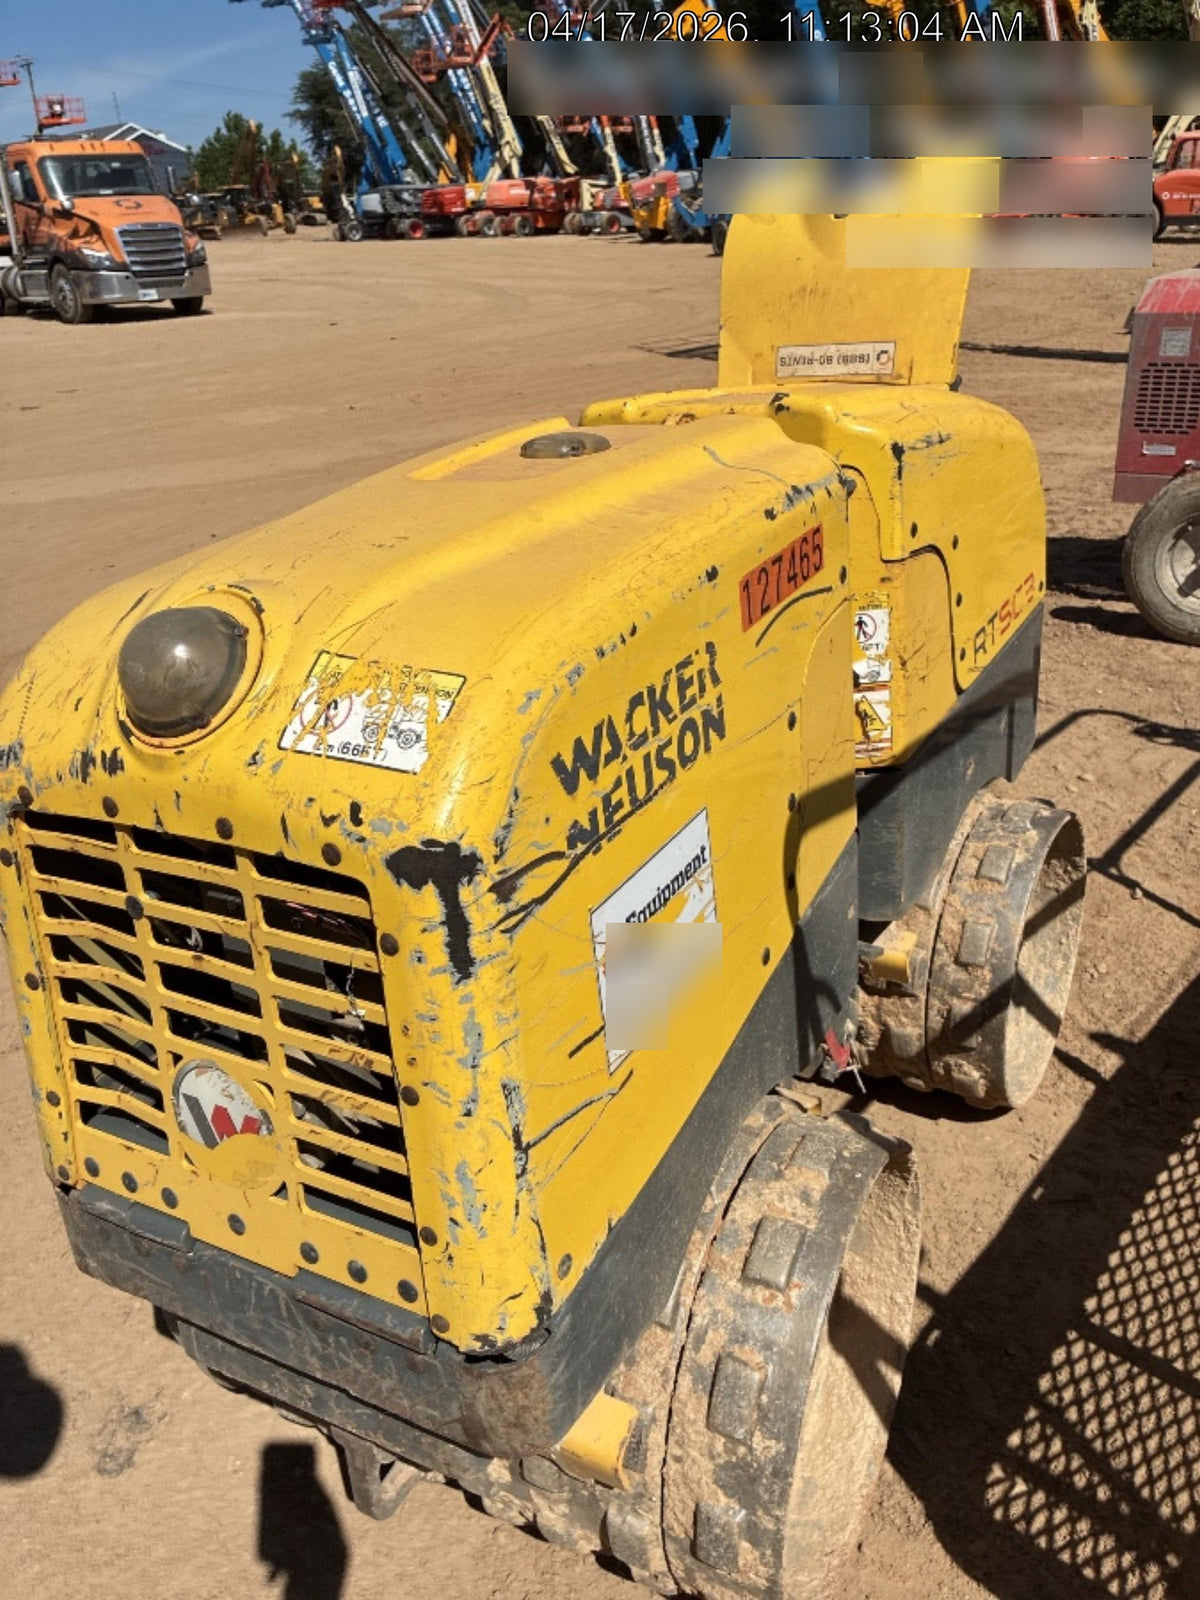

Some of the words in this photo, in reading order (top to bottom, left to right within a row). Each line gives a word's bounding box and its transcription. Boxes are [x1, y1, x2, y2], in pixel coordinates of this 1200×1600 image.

[742, 527, 824, 625] 127465
[551, 641, 721, 796] WACKER
[567, 694, 726, 851] NEUSON
[625, 844, 707, 923] Equipment
